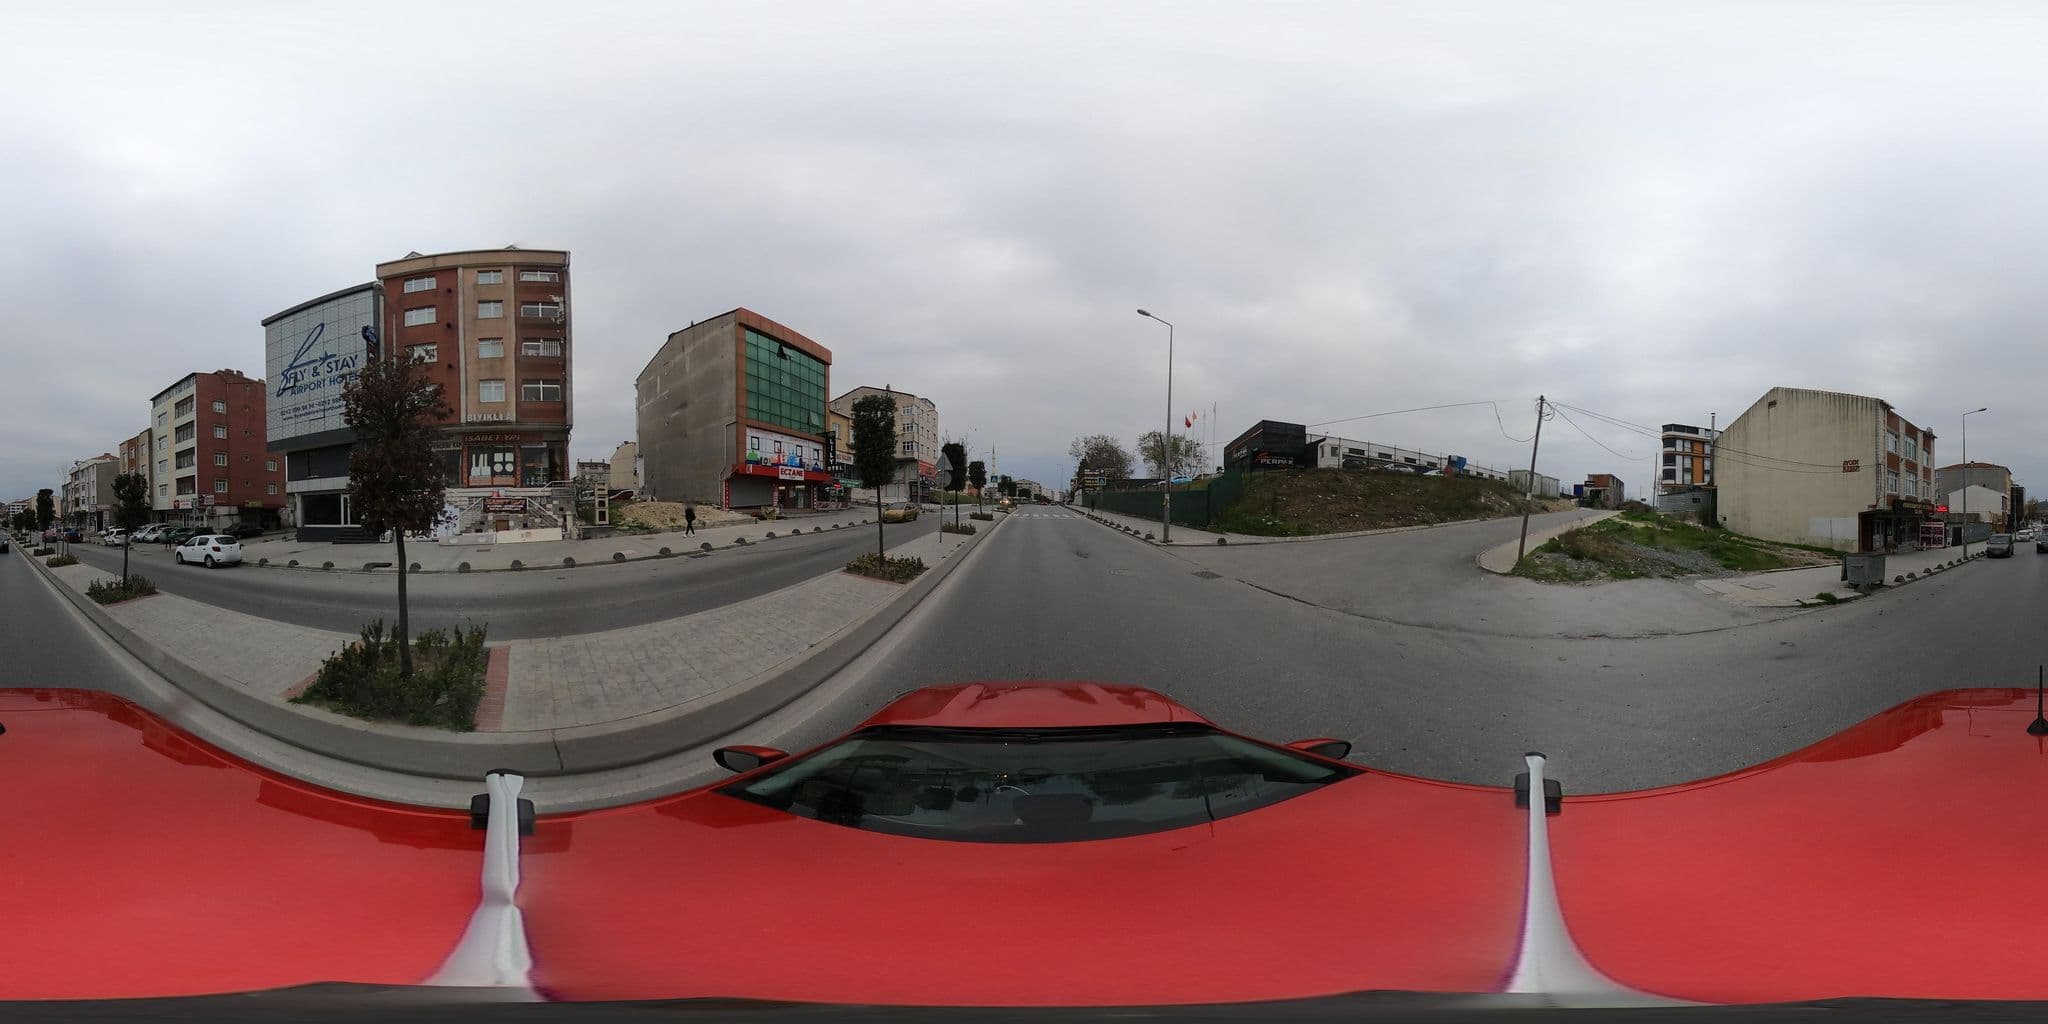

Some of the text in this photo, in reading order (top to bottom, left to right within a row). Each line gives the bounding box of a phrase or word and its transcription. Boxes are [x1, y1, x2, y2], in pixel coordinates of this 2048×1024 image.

[312, 366, 320, 377] &
[326, 355, 358, 373] STAY
[290, 379, 325, 396] AIRPORT
[781, 468, 803, 477] ECZANE
